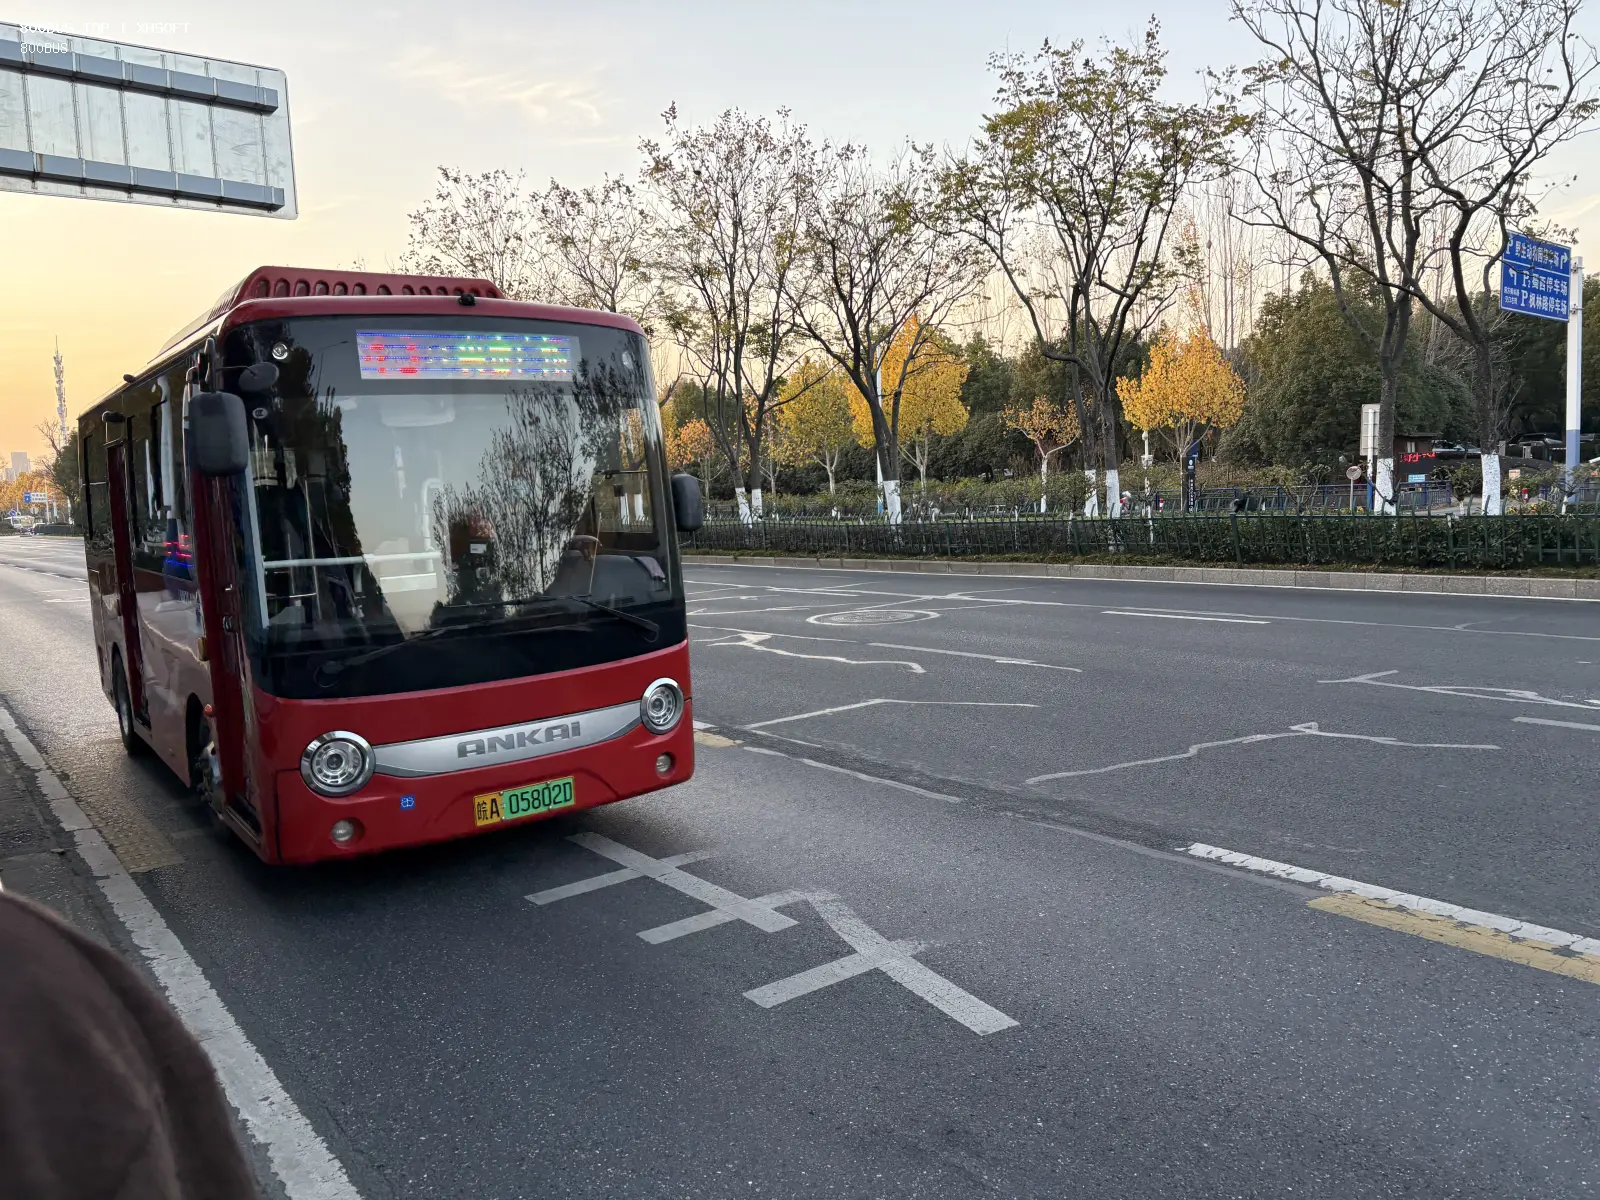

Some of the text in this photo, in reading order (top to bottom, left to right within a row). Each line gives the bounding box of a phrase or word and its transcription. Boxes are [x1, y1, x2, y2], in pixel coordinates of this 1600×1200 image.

[1532, 273, 1568, 296] 蜀西停车场
[1521, 290, 1528, 306] P
[1529, 292, 1567, 315] 枫林路停车场
[457, 721, 581, 758] ANKAI
